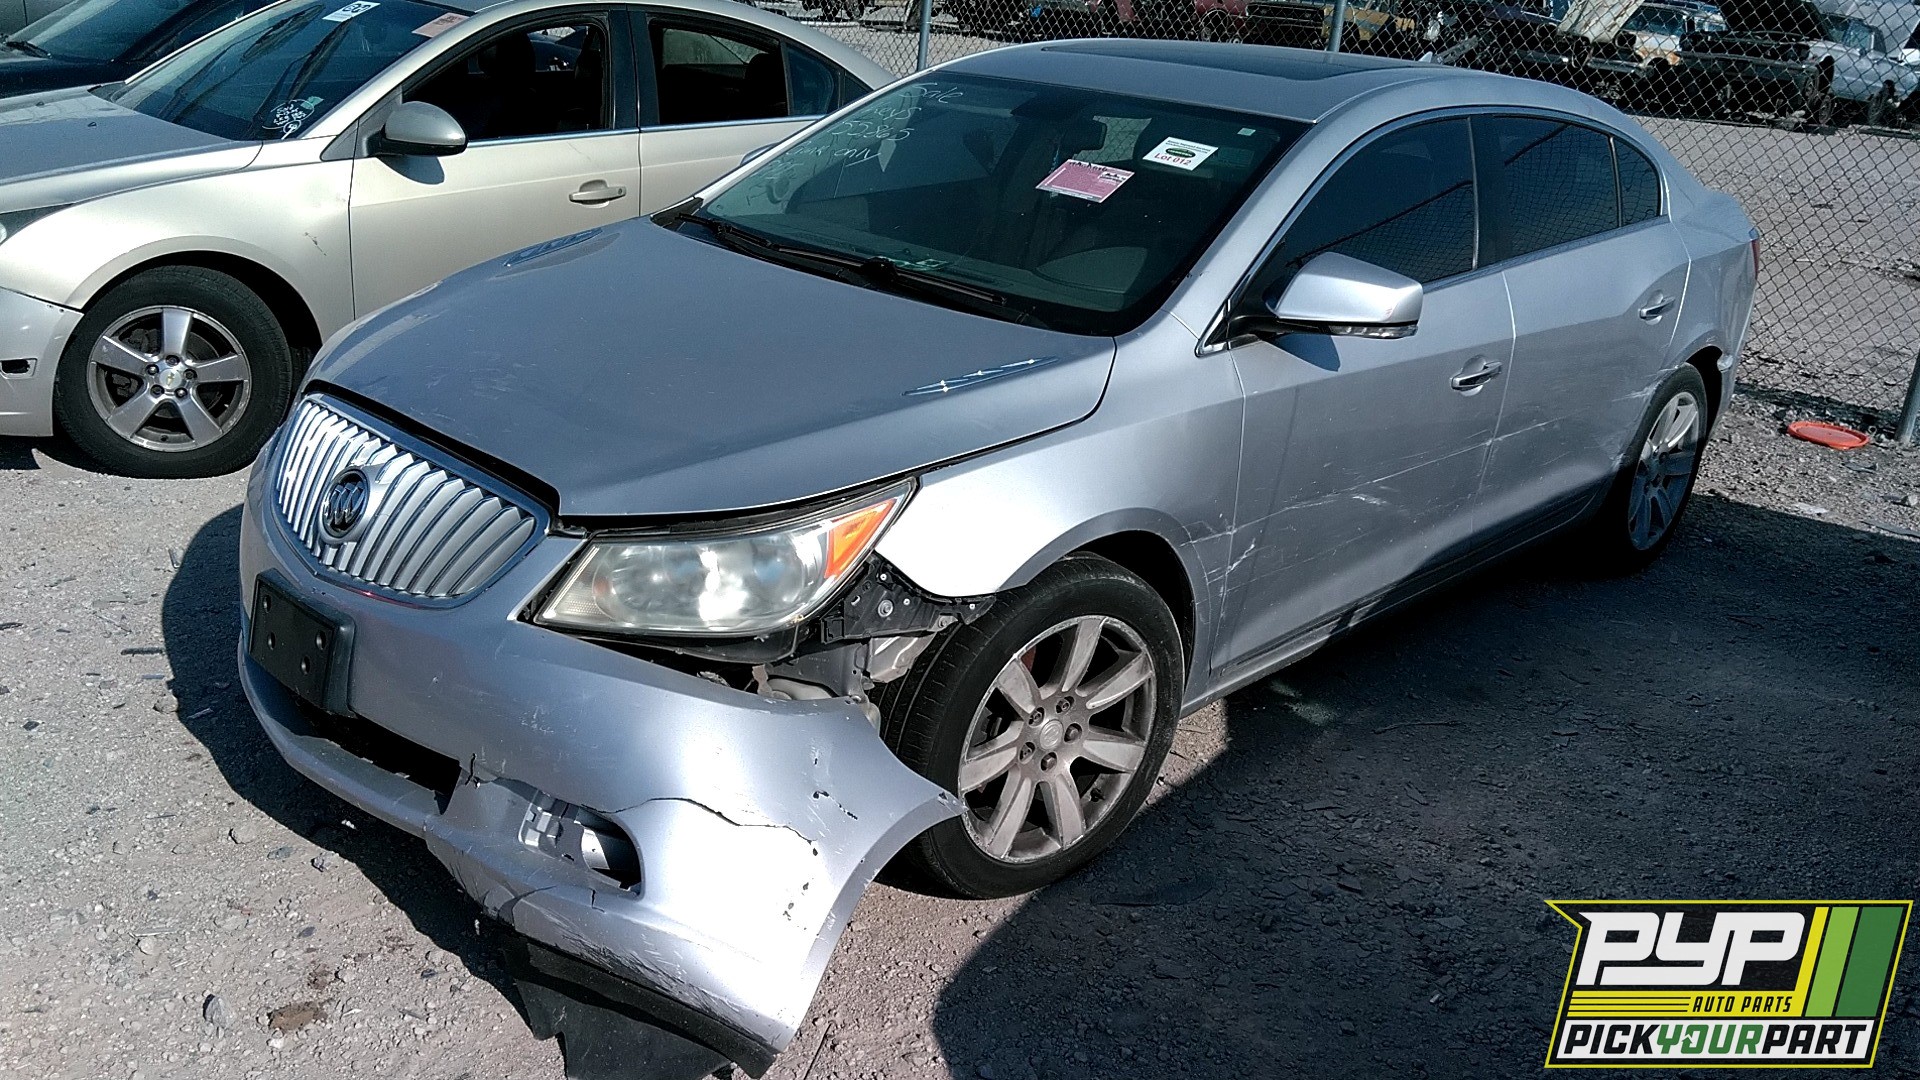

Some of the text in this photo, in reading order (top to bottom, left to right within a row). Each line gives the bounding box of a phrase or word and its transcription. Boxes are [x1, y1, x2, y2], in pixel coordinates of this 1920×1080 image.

[898, 82, 964, 104] Sale
[1154, 152, 1172, 162] Lot
[1172, 157, 1192, 166] 012
